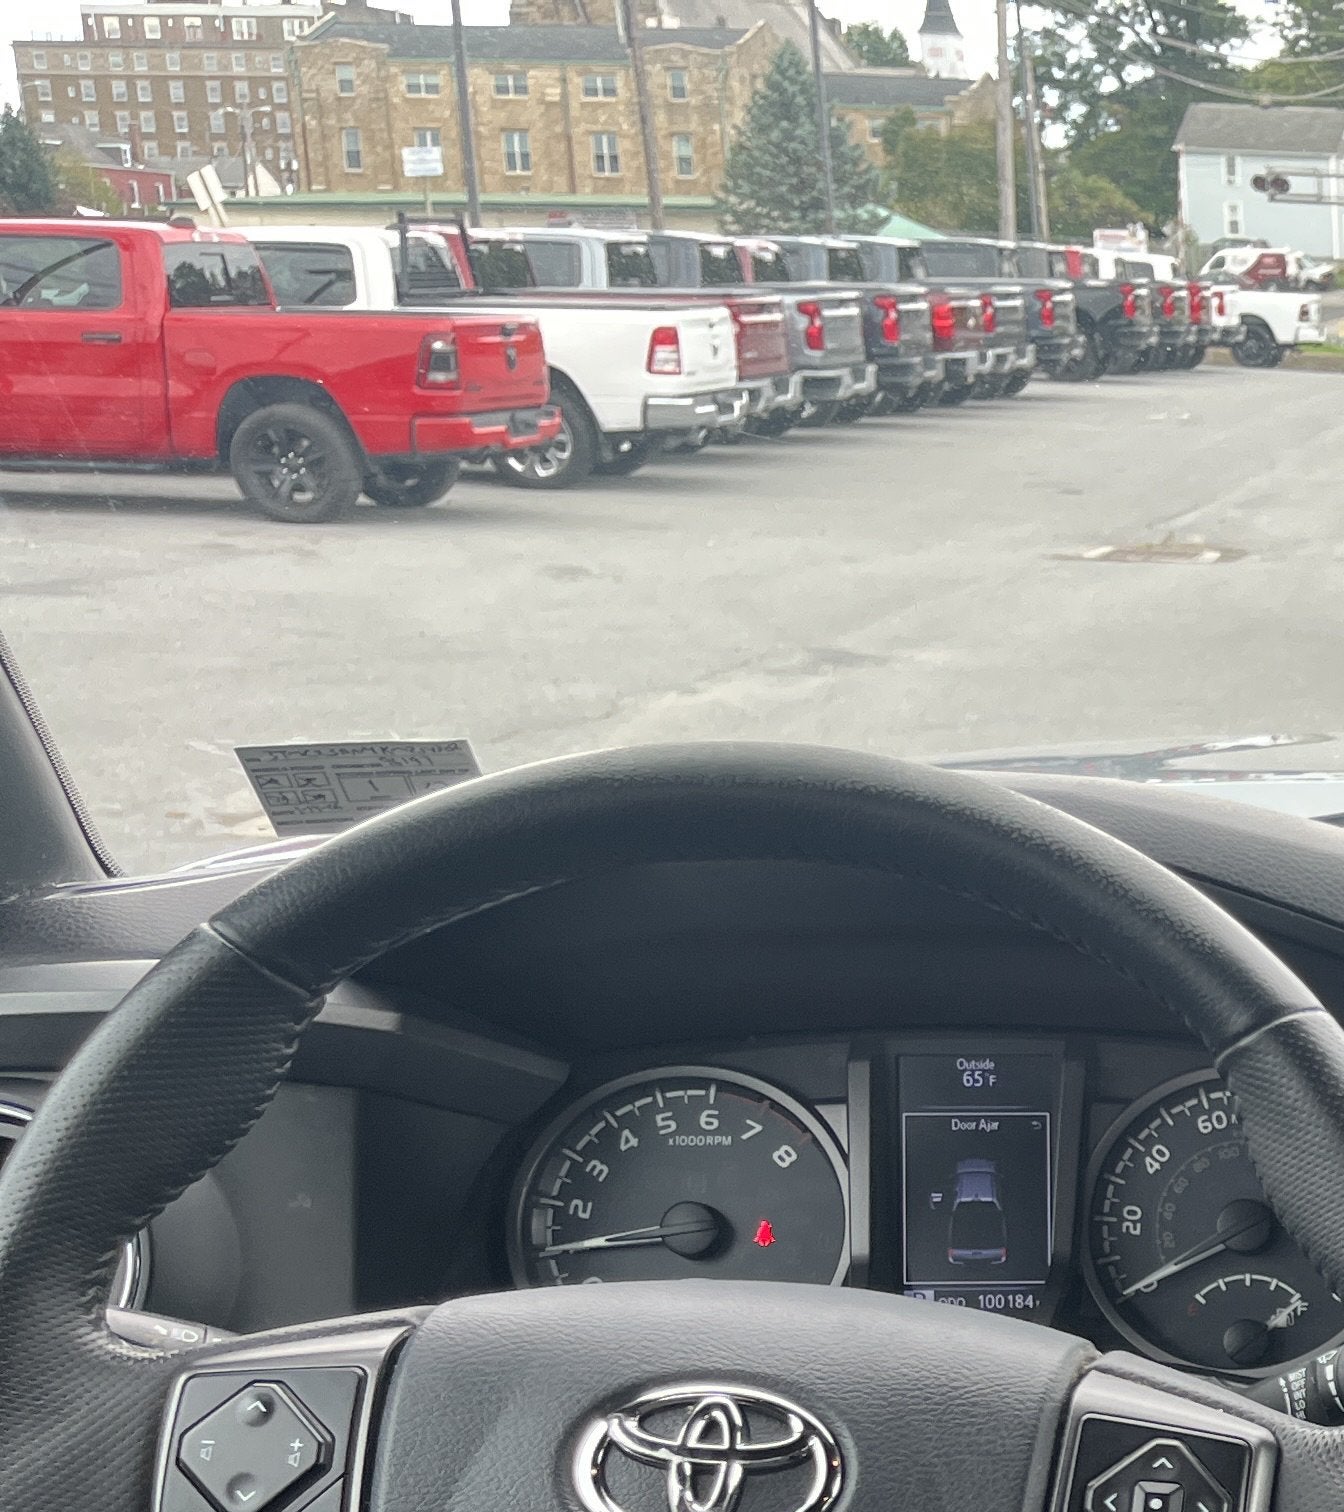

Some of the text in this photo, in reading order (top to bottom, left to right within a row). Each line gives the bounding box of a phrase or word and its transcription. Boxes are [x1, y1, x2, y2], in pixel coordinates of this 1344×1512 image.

[956, 1058, 995, 1070] Outside
[655, 1111, 677, 1135] 5
[699, 1110, 720, 1130] 6
[740, 1119, 763, 1140] 7
[951, 1118, 1000, 1132] Door Ajar
[1197, 1110, 1228, 1135] 60
[619, 1128, 639, 1152] 4
[772, 1145, 798, 1168] 8
[1144, 1143, 1171, 1175] 40
[585, 1159, 609, 1182] 3
[569, 1199, 593, 1219] 2
[1122, 1205, 1142, 1236] 20
[978, 1294, 1033, 1309] 100184
